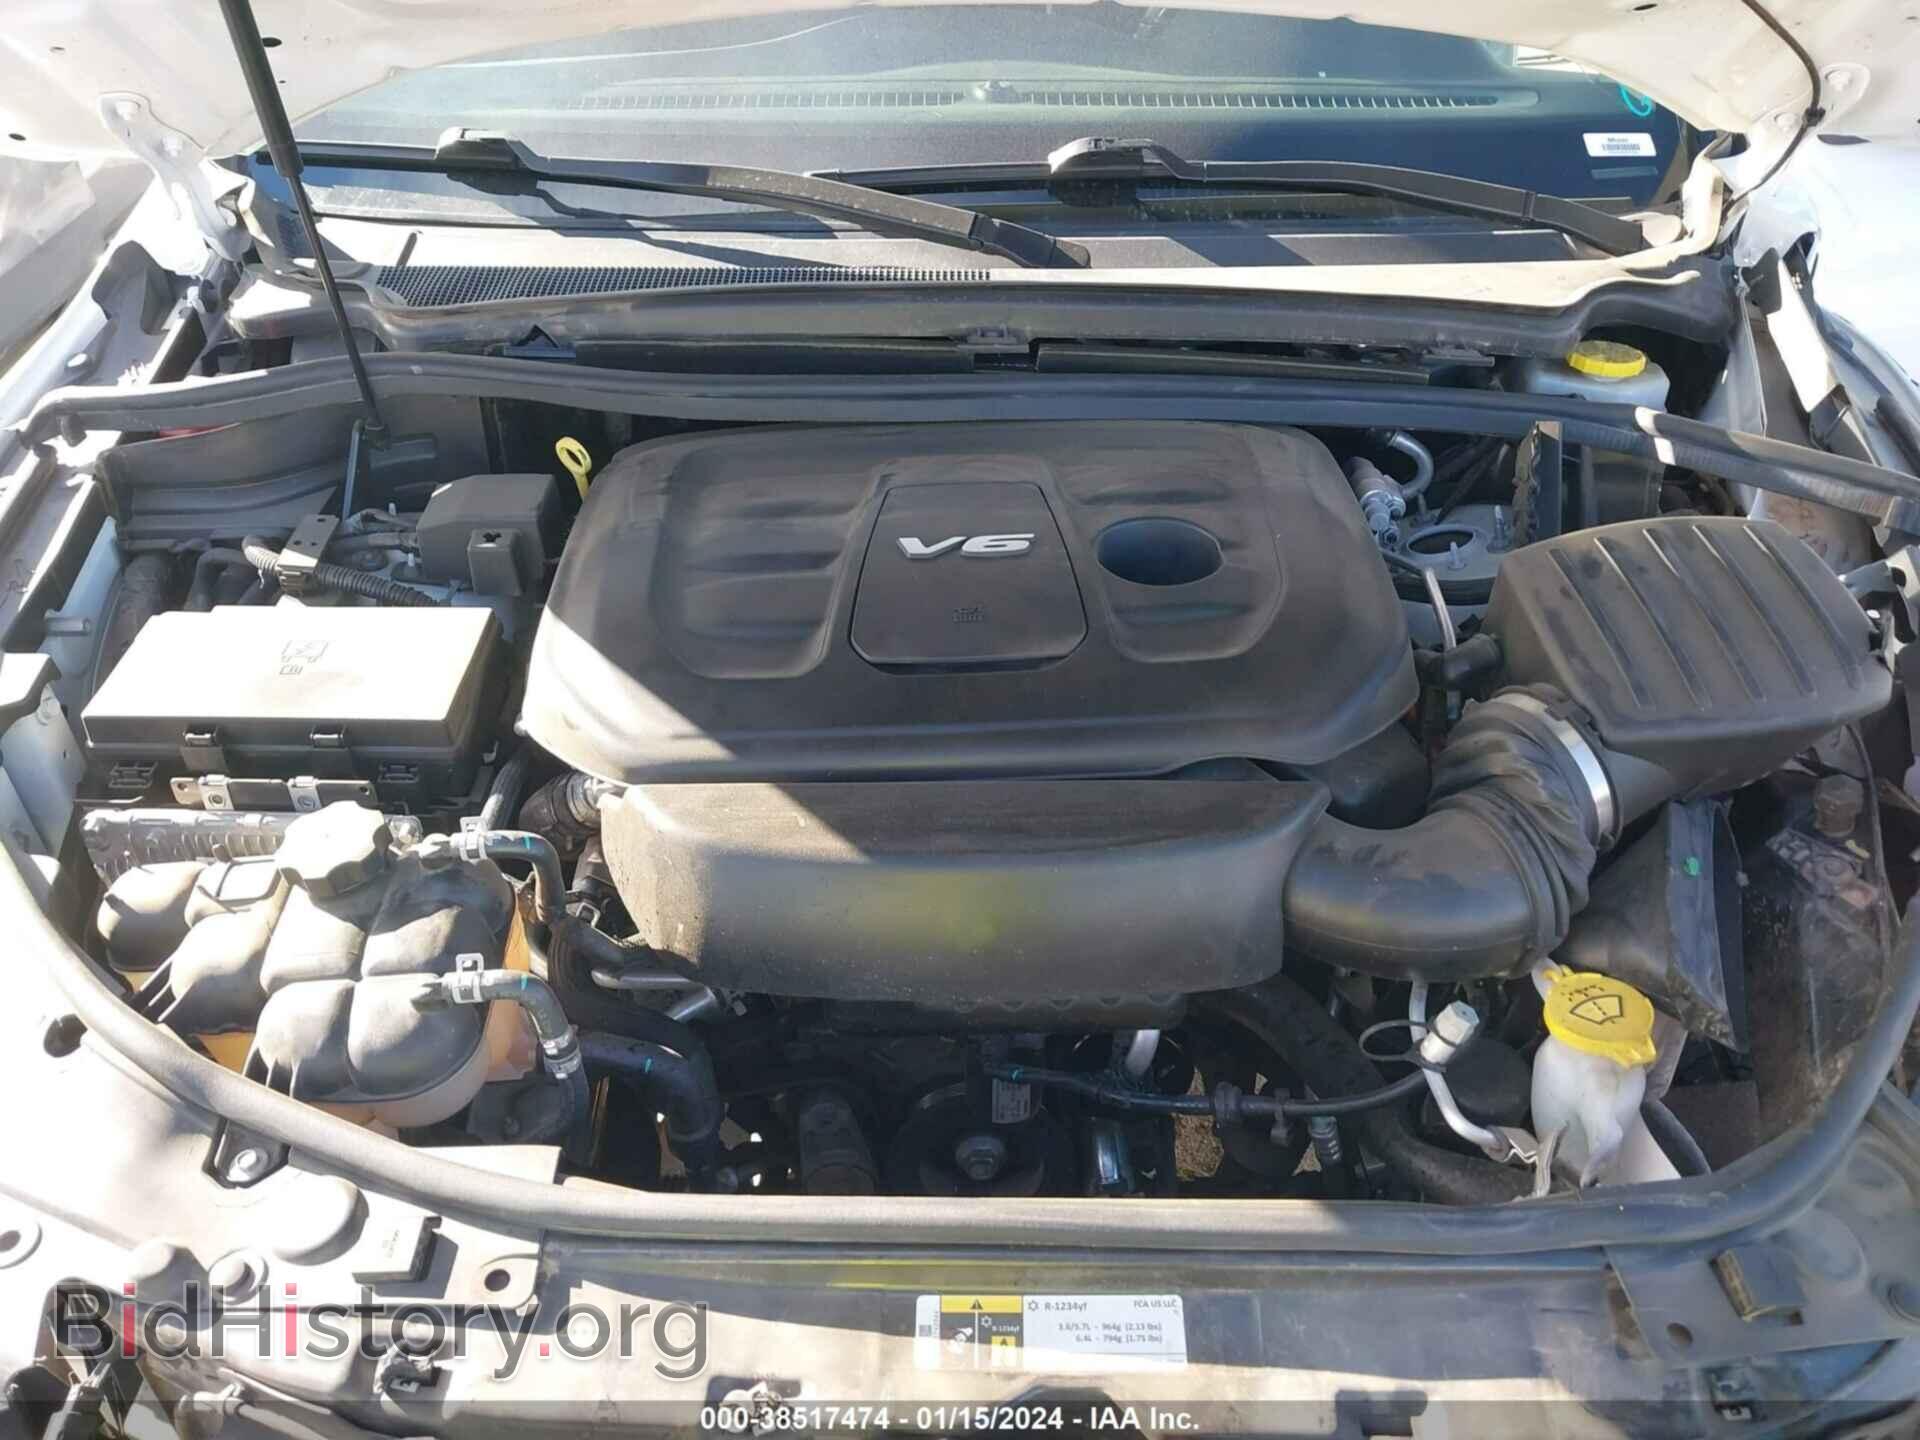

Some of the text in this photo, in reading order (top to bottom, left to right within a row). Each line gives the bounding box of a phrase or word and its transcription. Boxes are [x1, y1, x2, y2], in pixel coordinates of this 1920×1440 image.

[897, 533, 1035, 559] V6
[1044, 1301, 1087, 1312] R-1234yf
[1134, 1300, 1149, 1308] FCA
[1151, 1300, 1161, 1308] US
